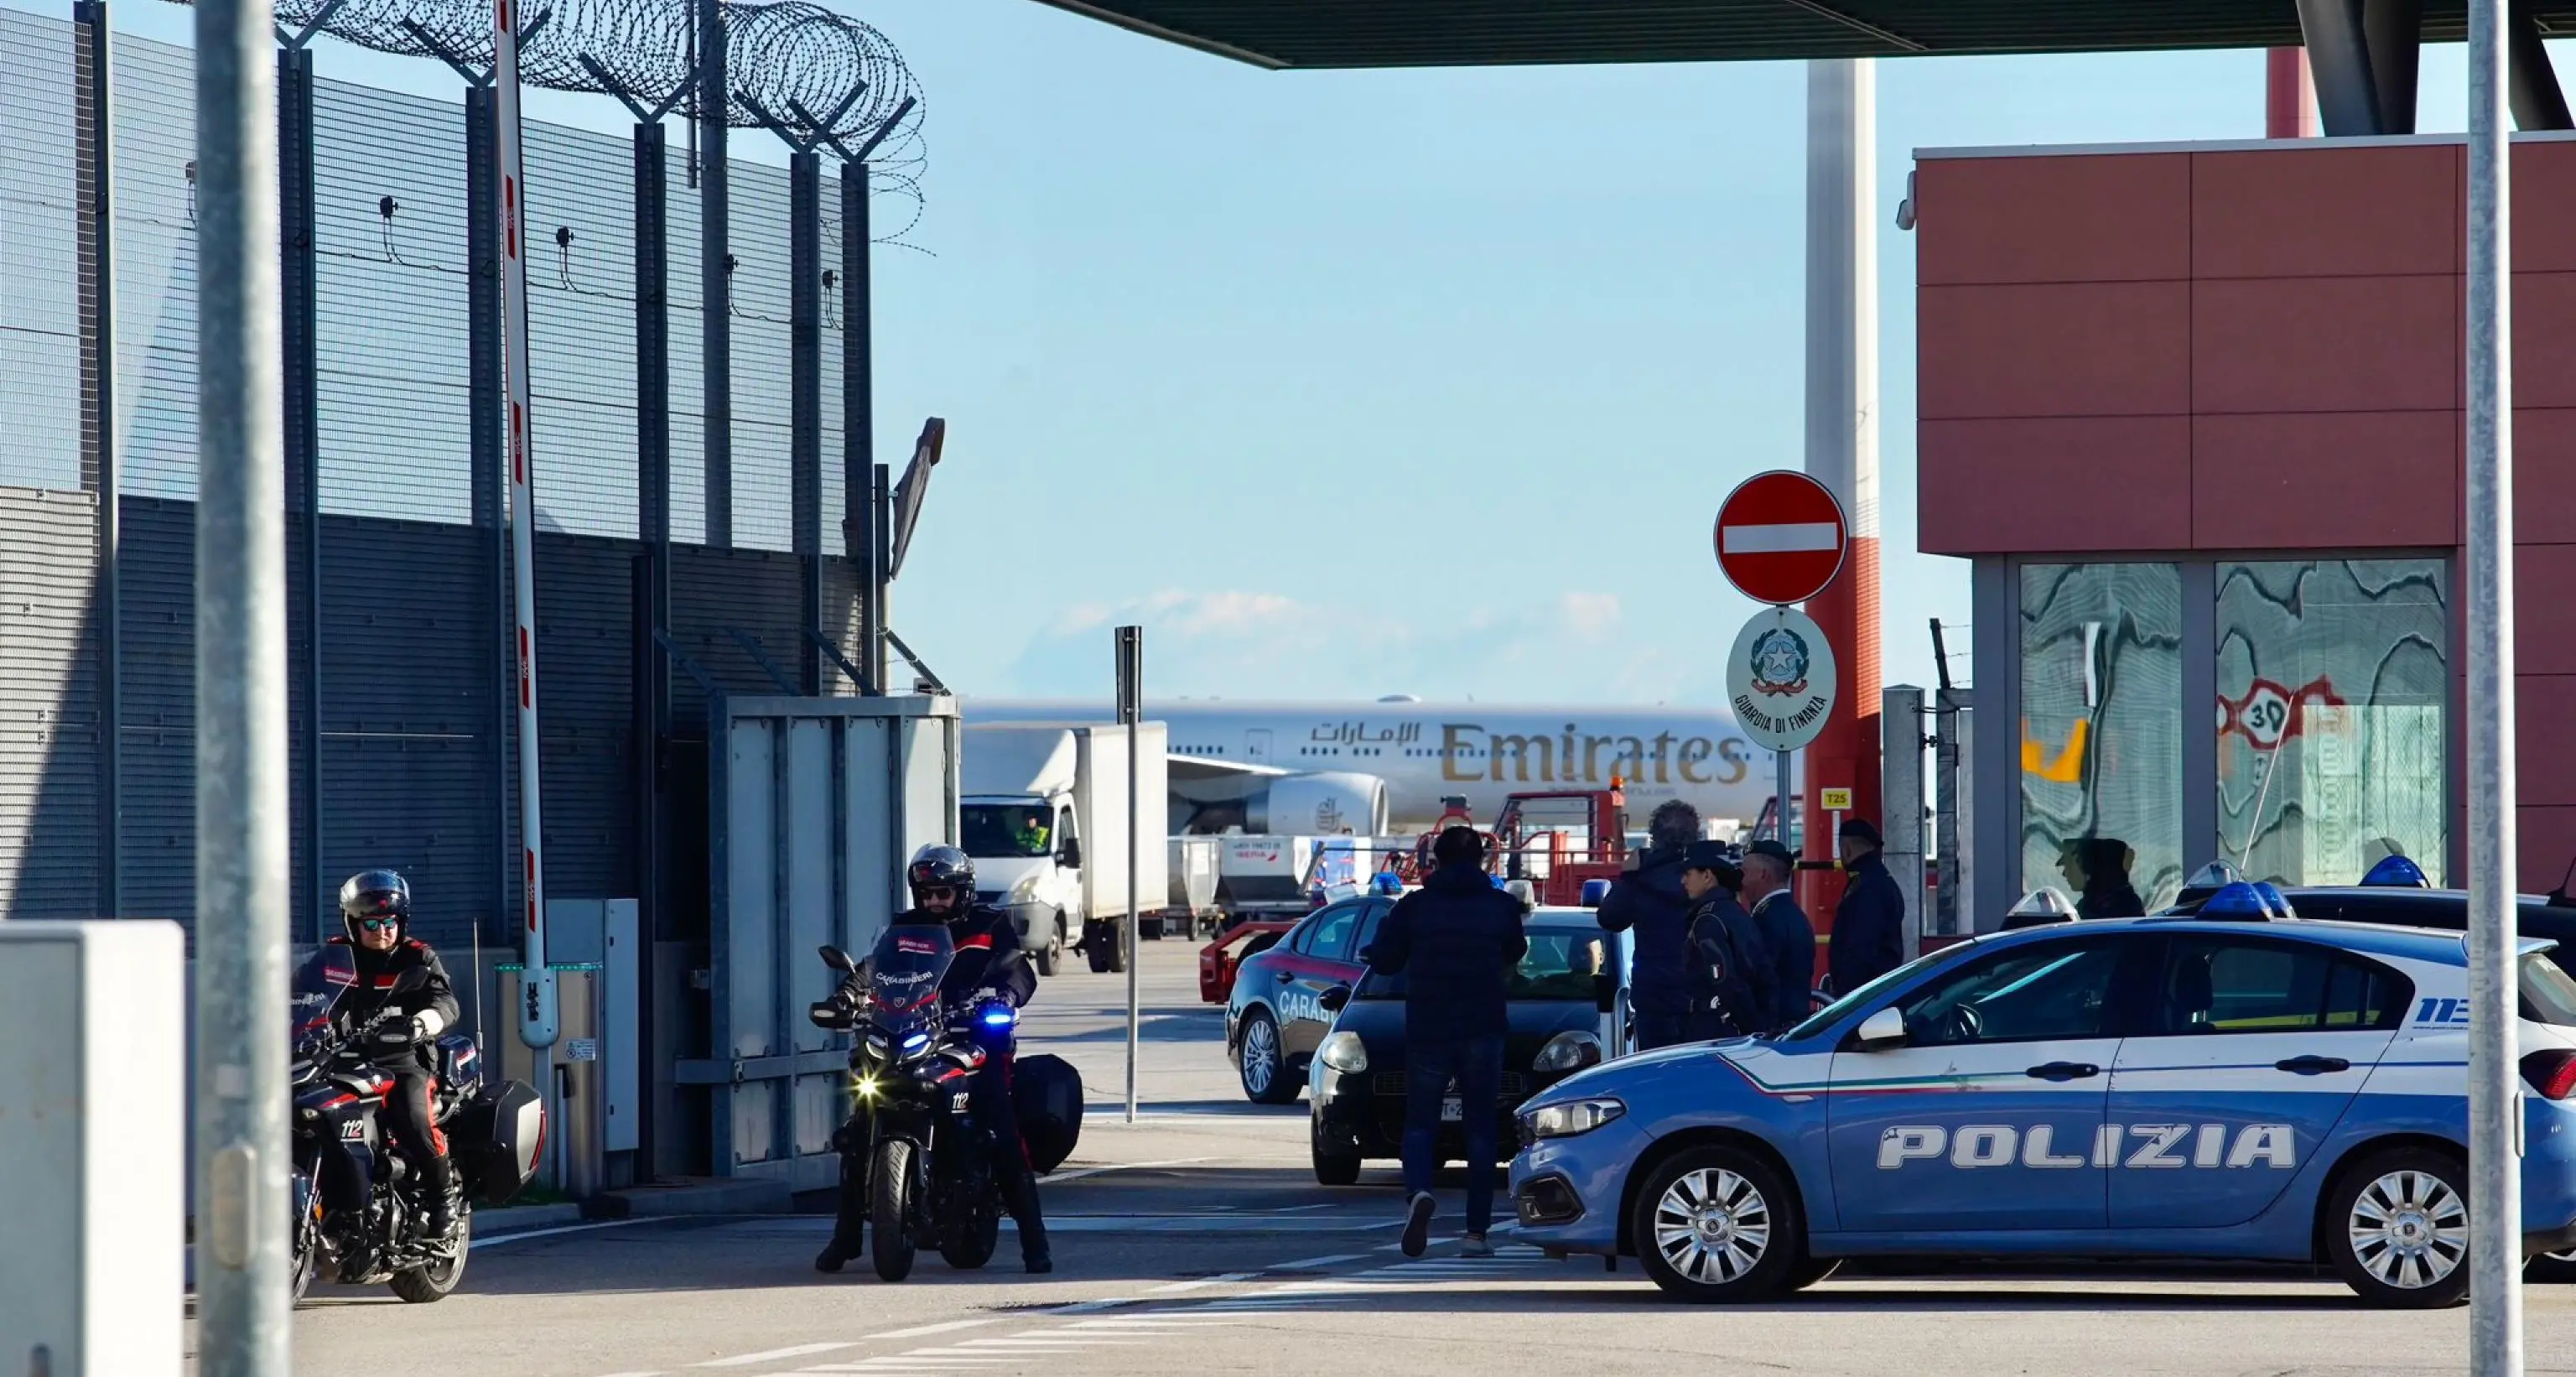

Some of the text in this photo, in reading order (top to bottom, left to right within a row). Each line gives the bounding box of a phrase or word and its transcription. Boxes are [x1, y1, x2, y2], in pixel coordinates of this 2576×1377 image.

[1735, 694, 1827, 734] GUARDIA DI FINANZA
[1441, 724, 1748, 785] Emirates
[1826, 793, 1846, 804] T25
[953, 1092, 969, 1109] 112
[341, 1120, 364, 1139] 112
[1877, 1124, 2296, 1169] POLIZIA
